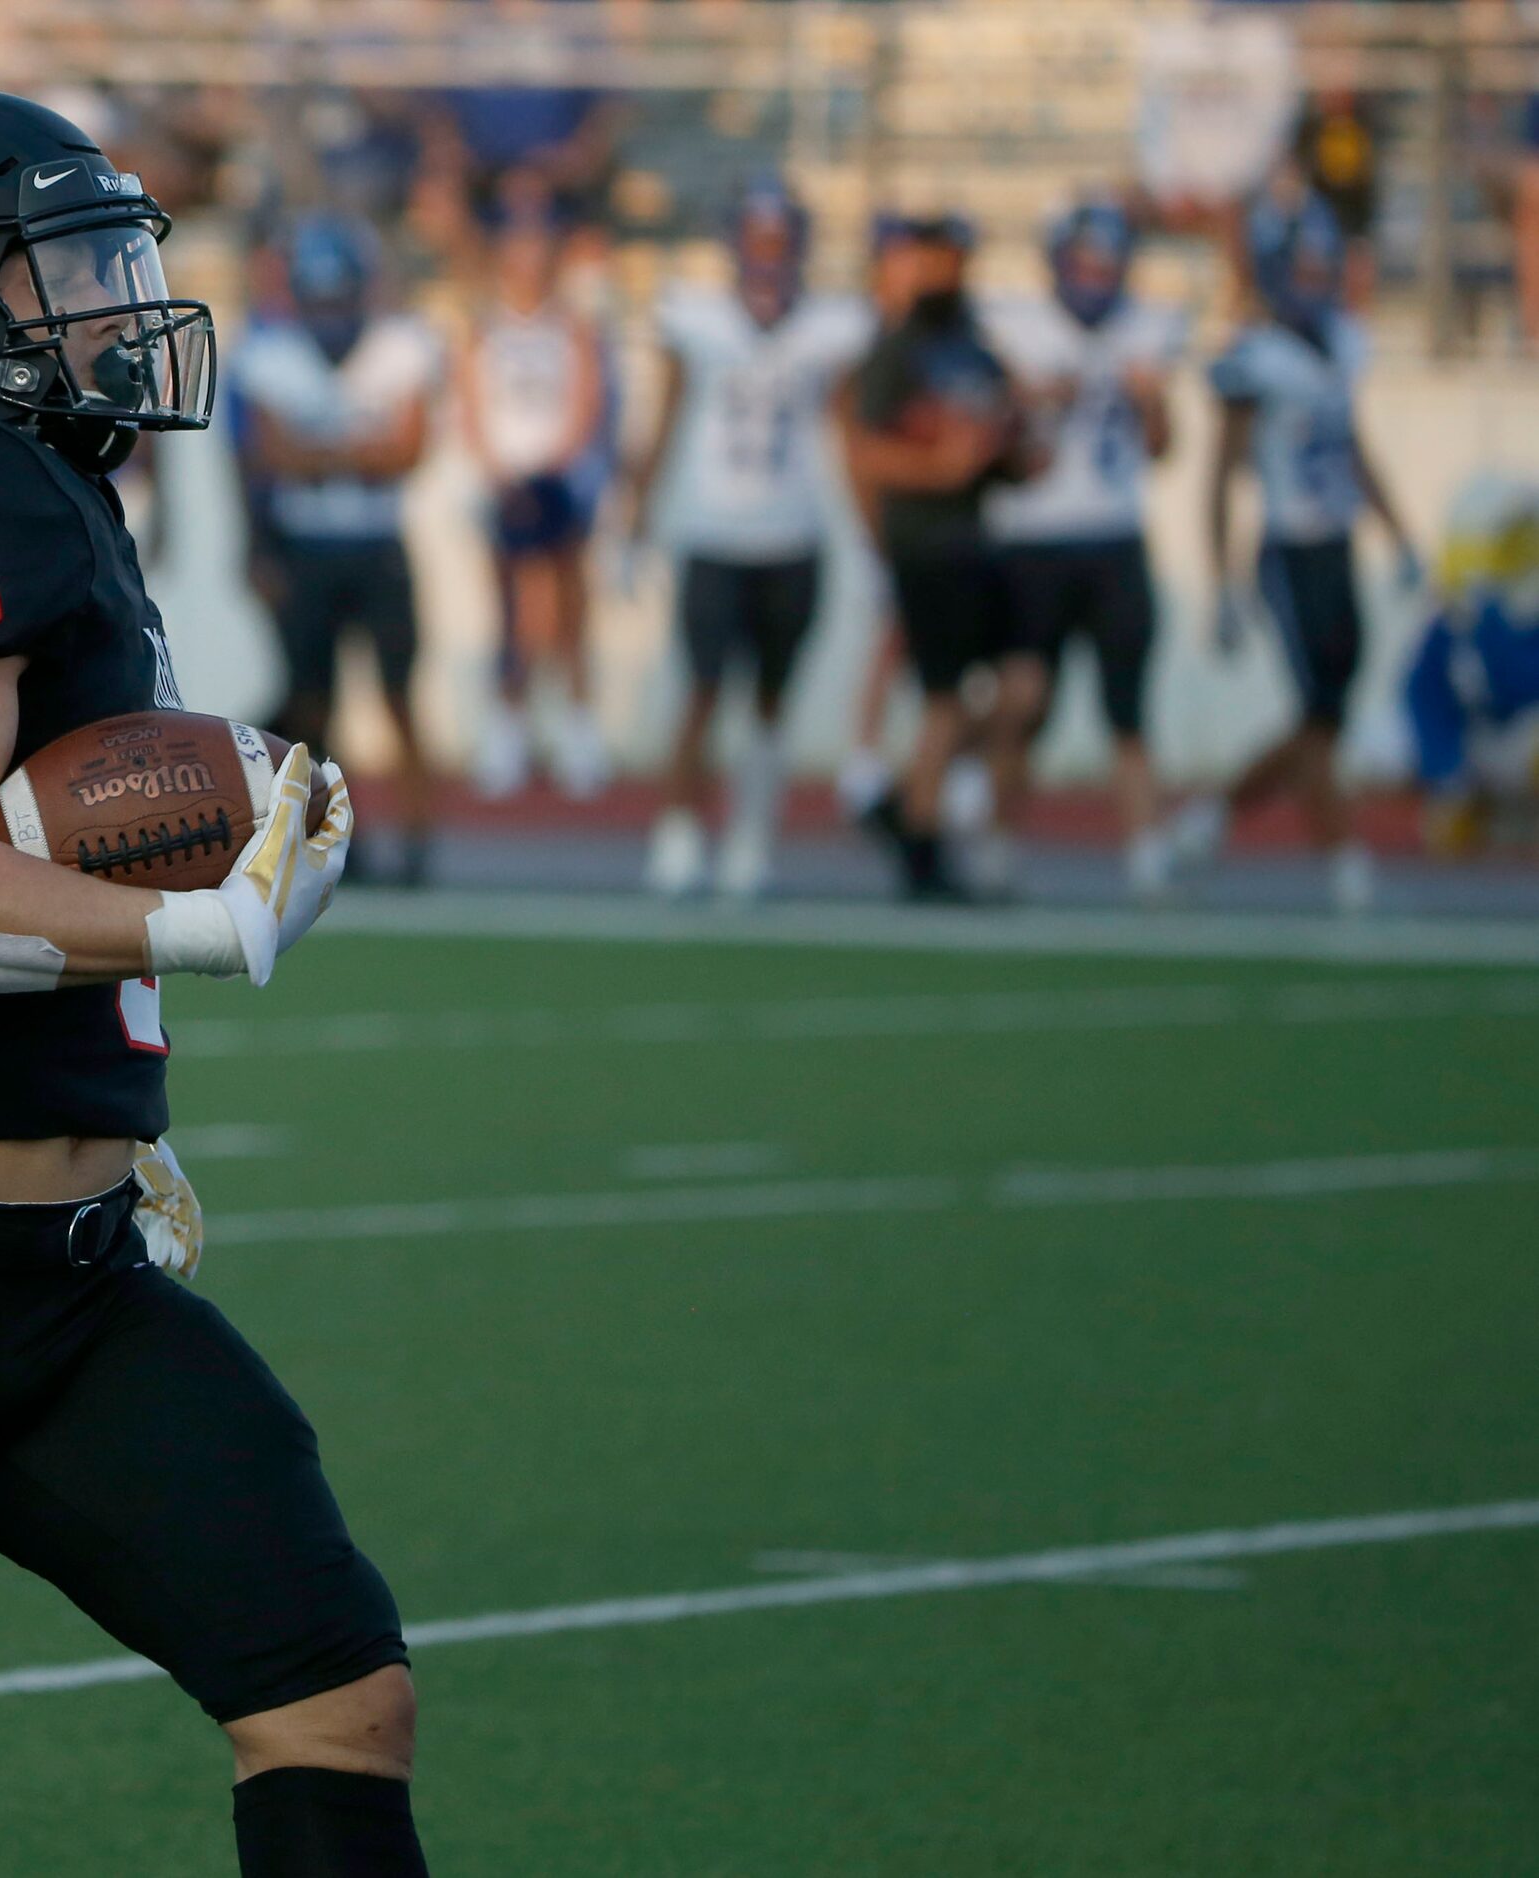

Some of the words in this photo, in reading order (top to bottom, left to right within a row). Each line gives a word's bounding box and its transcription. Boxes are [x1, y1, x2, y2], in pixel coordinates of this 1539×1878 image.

[103, 726, 160, 748] NCAA
[79, 763, 215, 806] Wilson
[14, 810, 40, 844] BT
